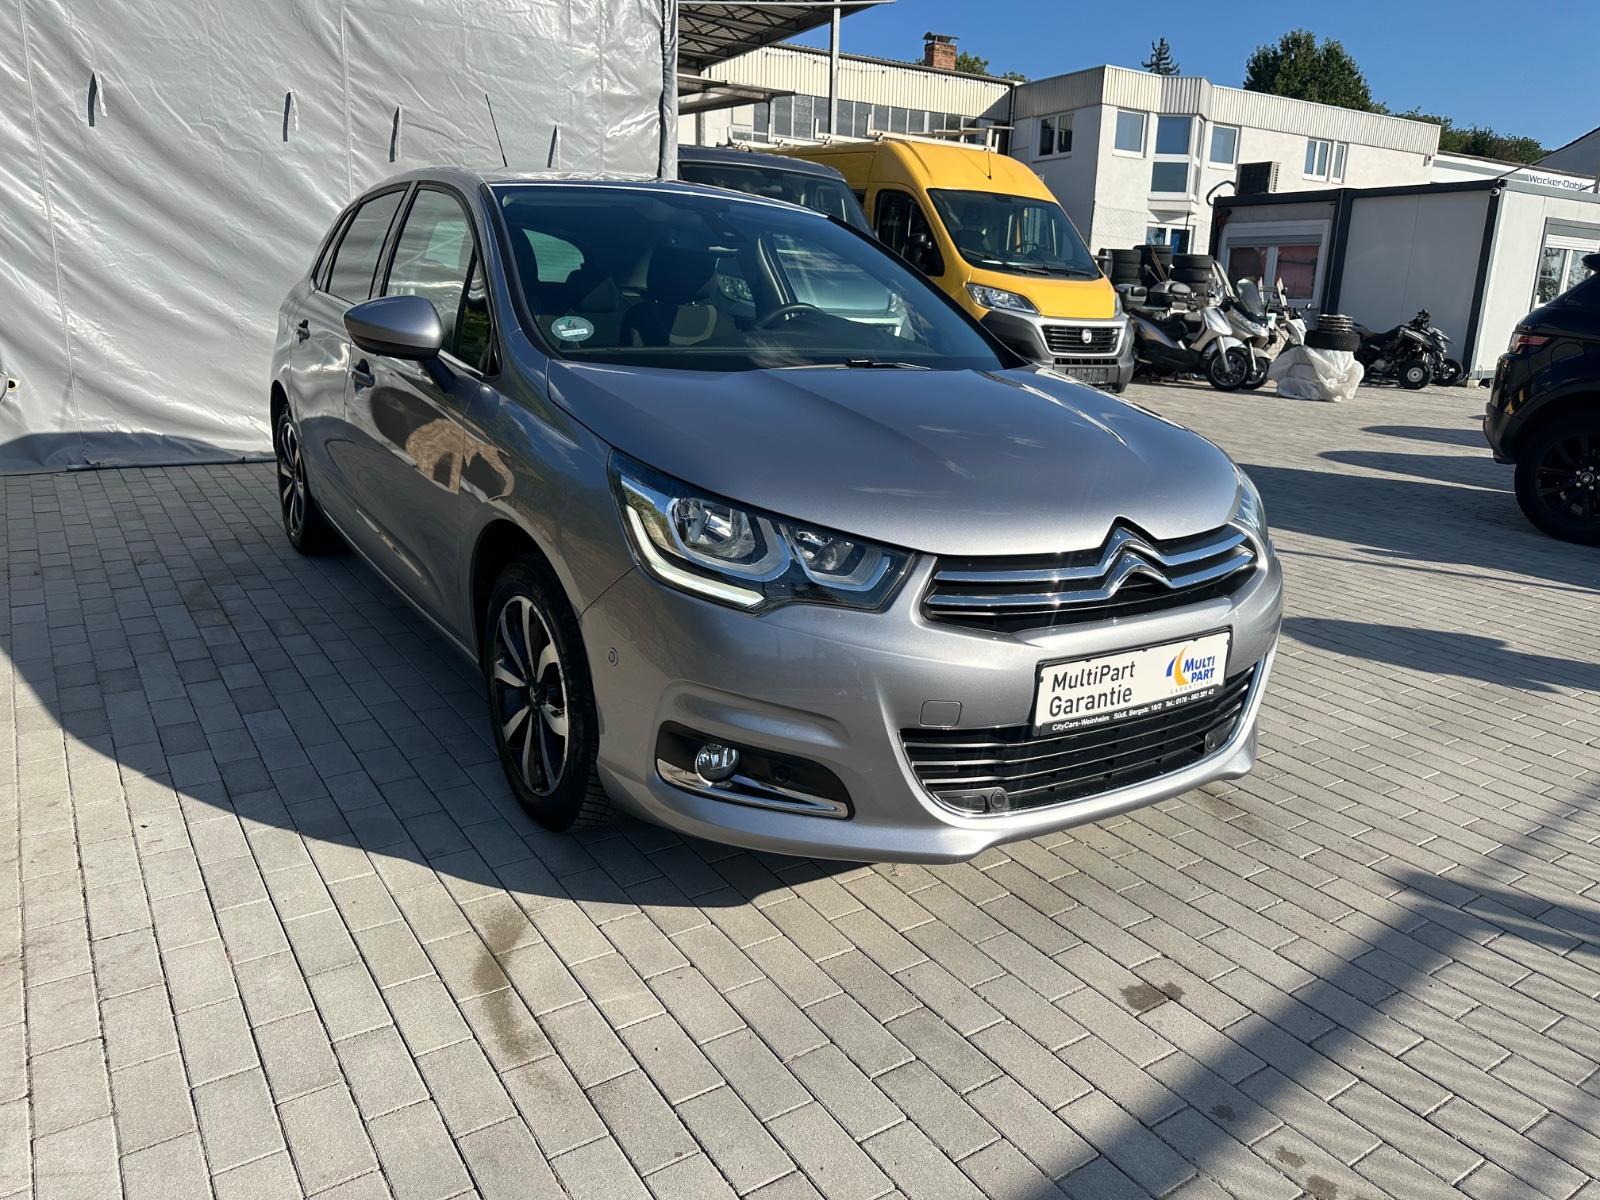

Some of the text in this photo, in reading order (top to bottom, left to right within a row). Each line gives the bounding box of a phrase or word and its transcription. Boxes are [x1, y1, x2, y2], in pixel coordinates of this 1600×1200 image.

[1051, 661, 1135, 692] MultiPart
[1183, 656, 1216, 673] MULTI
[1191, 667, 1215, 683] PART
[1049, 684, 1132, 717] Garantie
